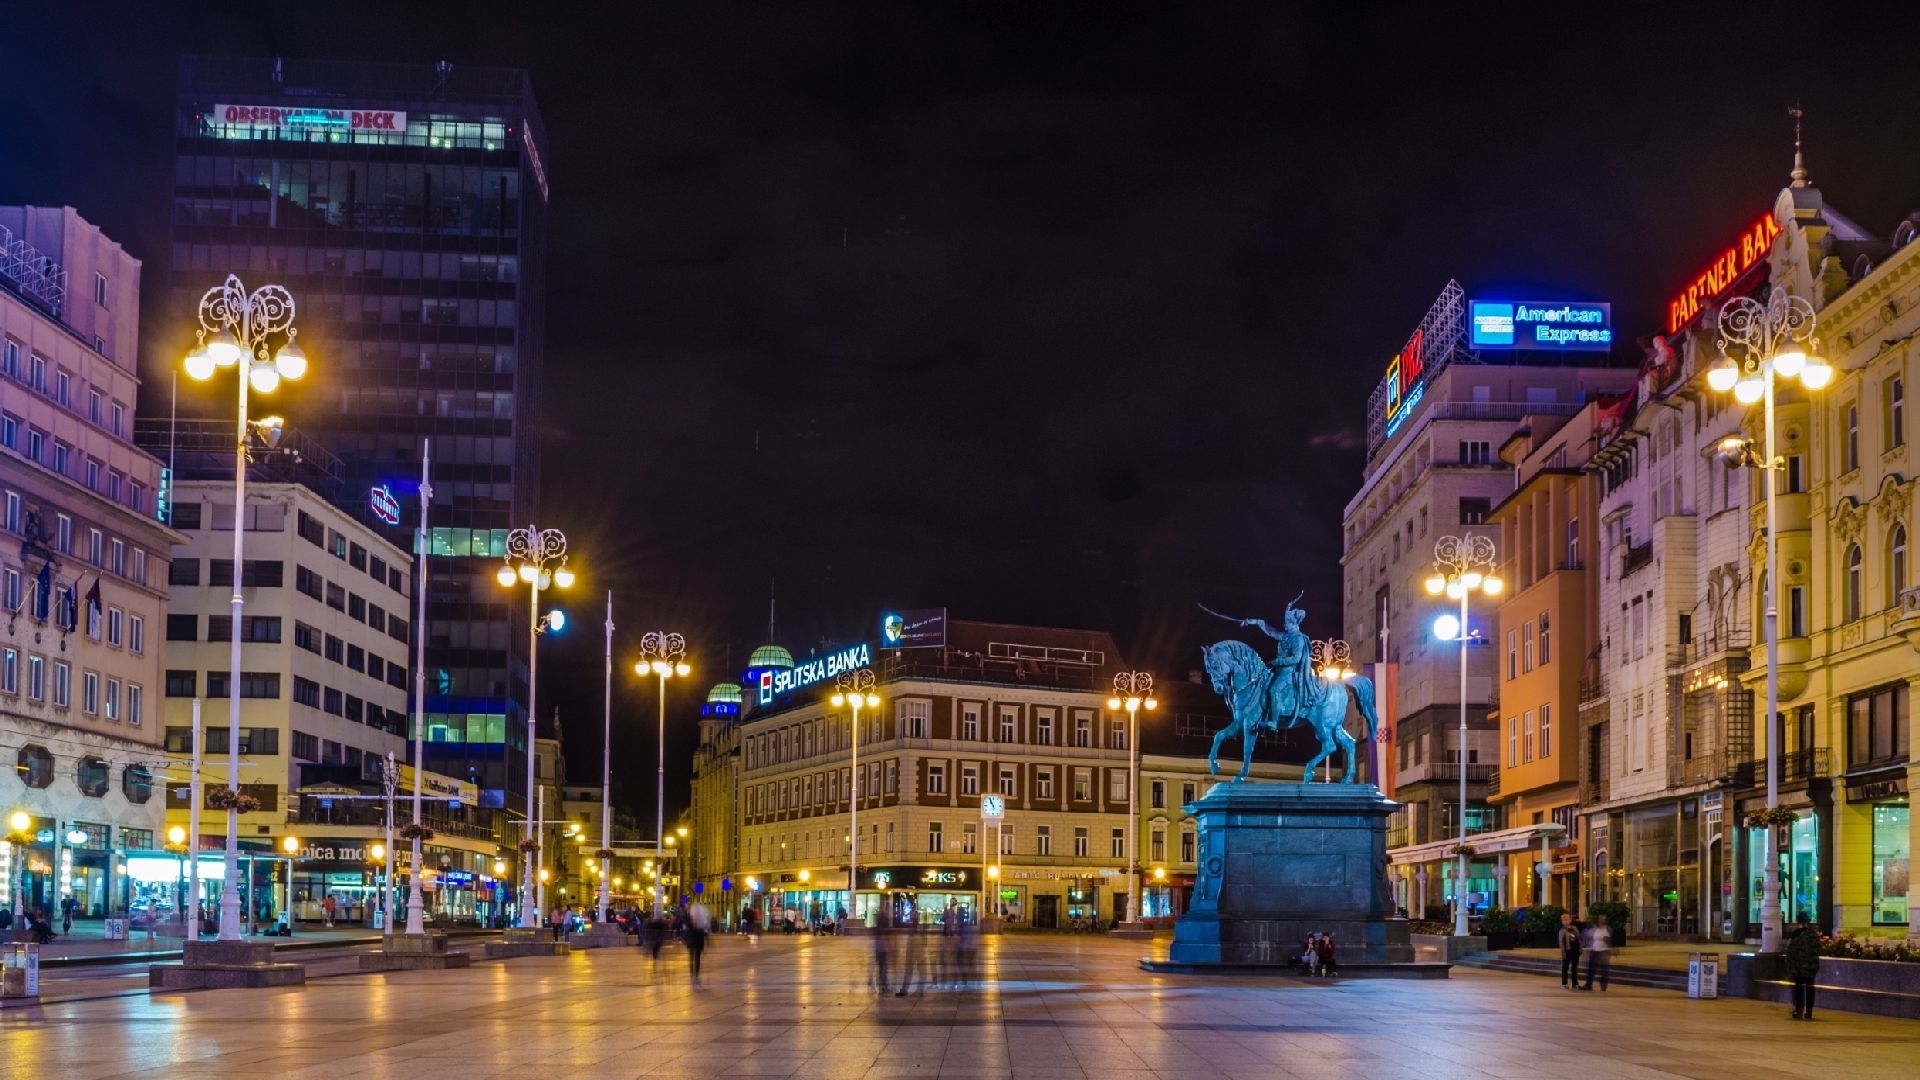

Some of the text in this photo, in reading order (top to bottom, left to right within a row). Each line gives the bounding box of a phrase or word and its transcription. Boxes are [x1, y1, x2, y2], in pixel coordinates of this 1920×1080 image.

[225, 105, 395, 129] OBSERVATION DECK
[1672, 214, 1779, 334] PARTNER BAN
[1515, 305, 1602, 322] American
[1536, 325, 1611, 344] Express
[1402, 329, 1423, 394] PBZ
[774, 644, 870, 694] SPLITSKA BANKA
[297, 843, 335, 862] pica
